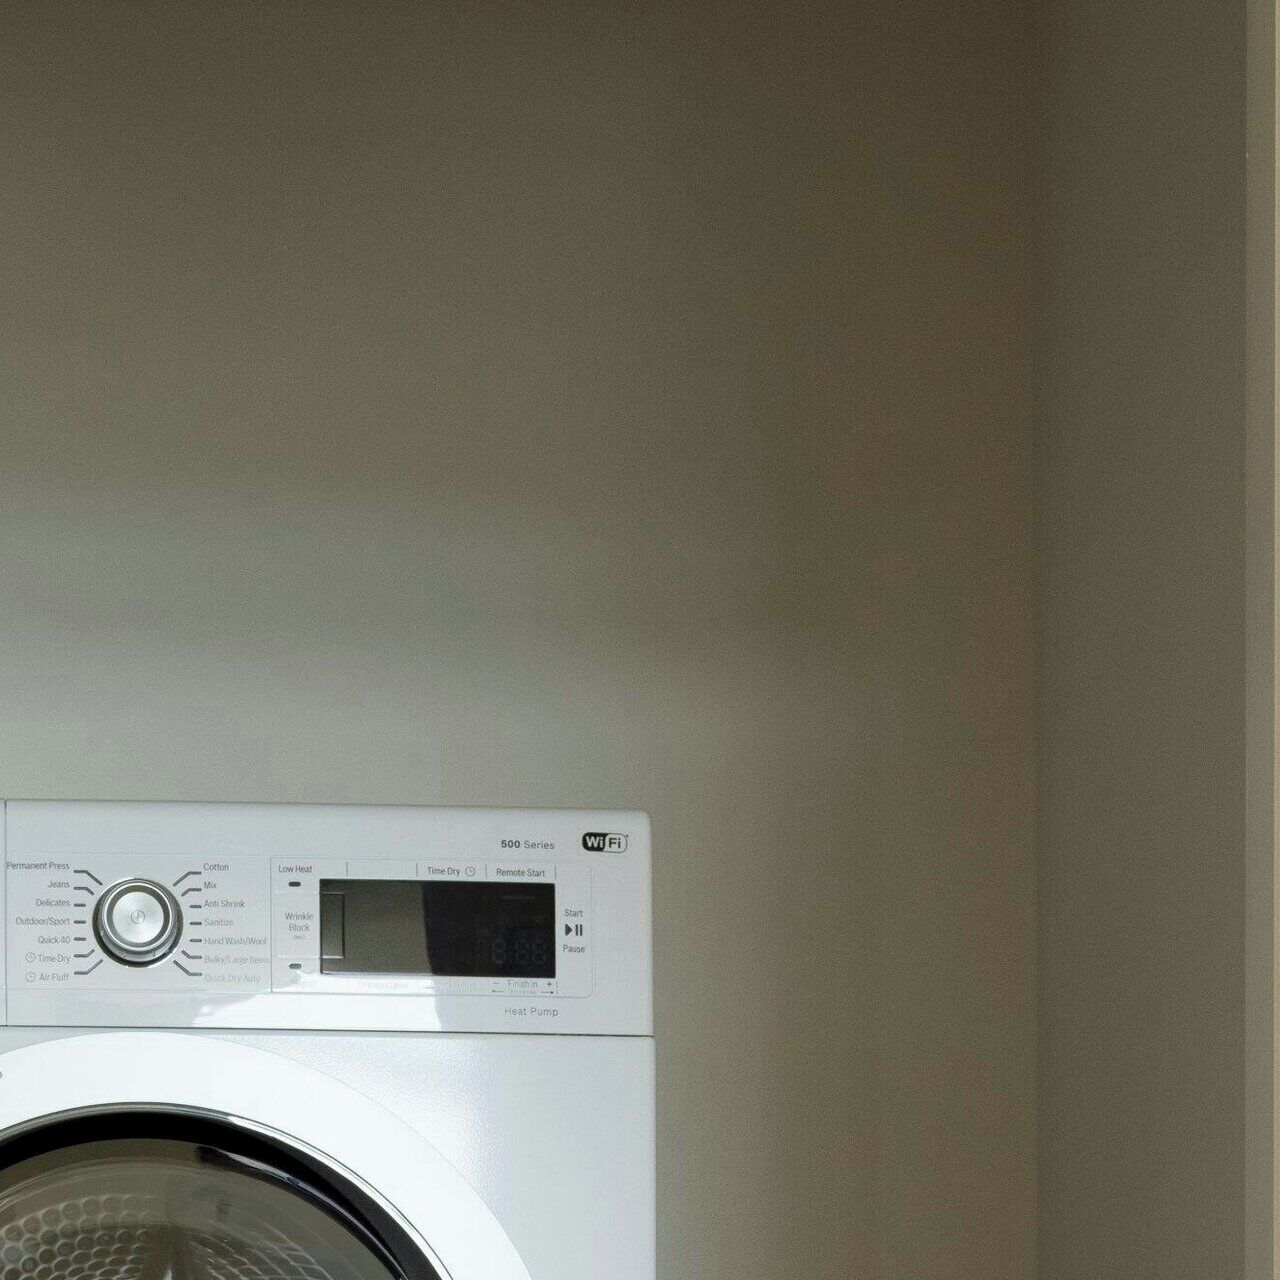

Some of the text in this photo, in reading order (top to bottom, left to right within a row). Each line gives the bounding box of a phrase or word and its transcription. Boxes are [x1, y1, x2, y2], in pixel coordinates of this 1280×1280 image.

[501, 840, 555, 850] 500 Series
[6, 862, 70, 870] Permanent Press
[203, 863, 229, 871] Cotton
[279, 865, 313, 873] Low Heat
[427, 867, 461, 877] Time Dry
[496, 868, 546, 877] Remote Start
[35, 898, 70, 907] Delicates
[204, 900, 245, 908] Anti Shrink
[285, 912, 314, 921] Wrinkle
[564, 909, 583, 917] Start
[15, 917, 70, 926] Outdoor/Sport
[204, 919, 233, 927] Sanitize
[289, 923, 310, 932] Block
[38, 935, 58, 944] Quick
[204, 937, 267, 946] Hand Wash/Wool
[563, 944, 585, 953] Pause
[38, 954, 70, 964] Time Dry
[205, 955, 251, 966] Bulky/Large
[40, 972, 69, 980] Air Fluff
[505, 1007, 559, 1017] Heat Pump
